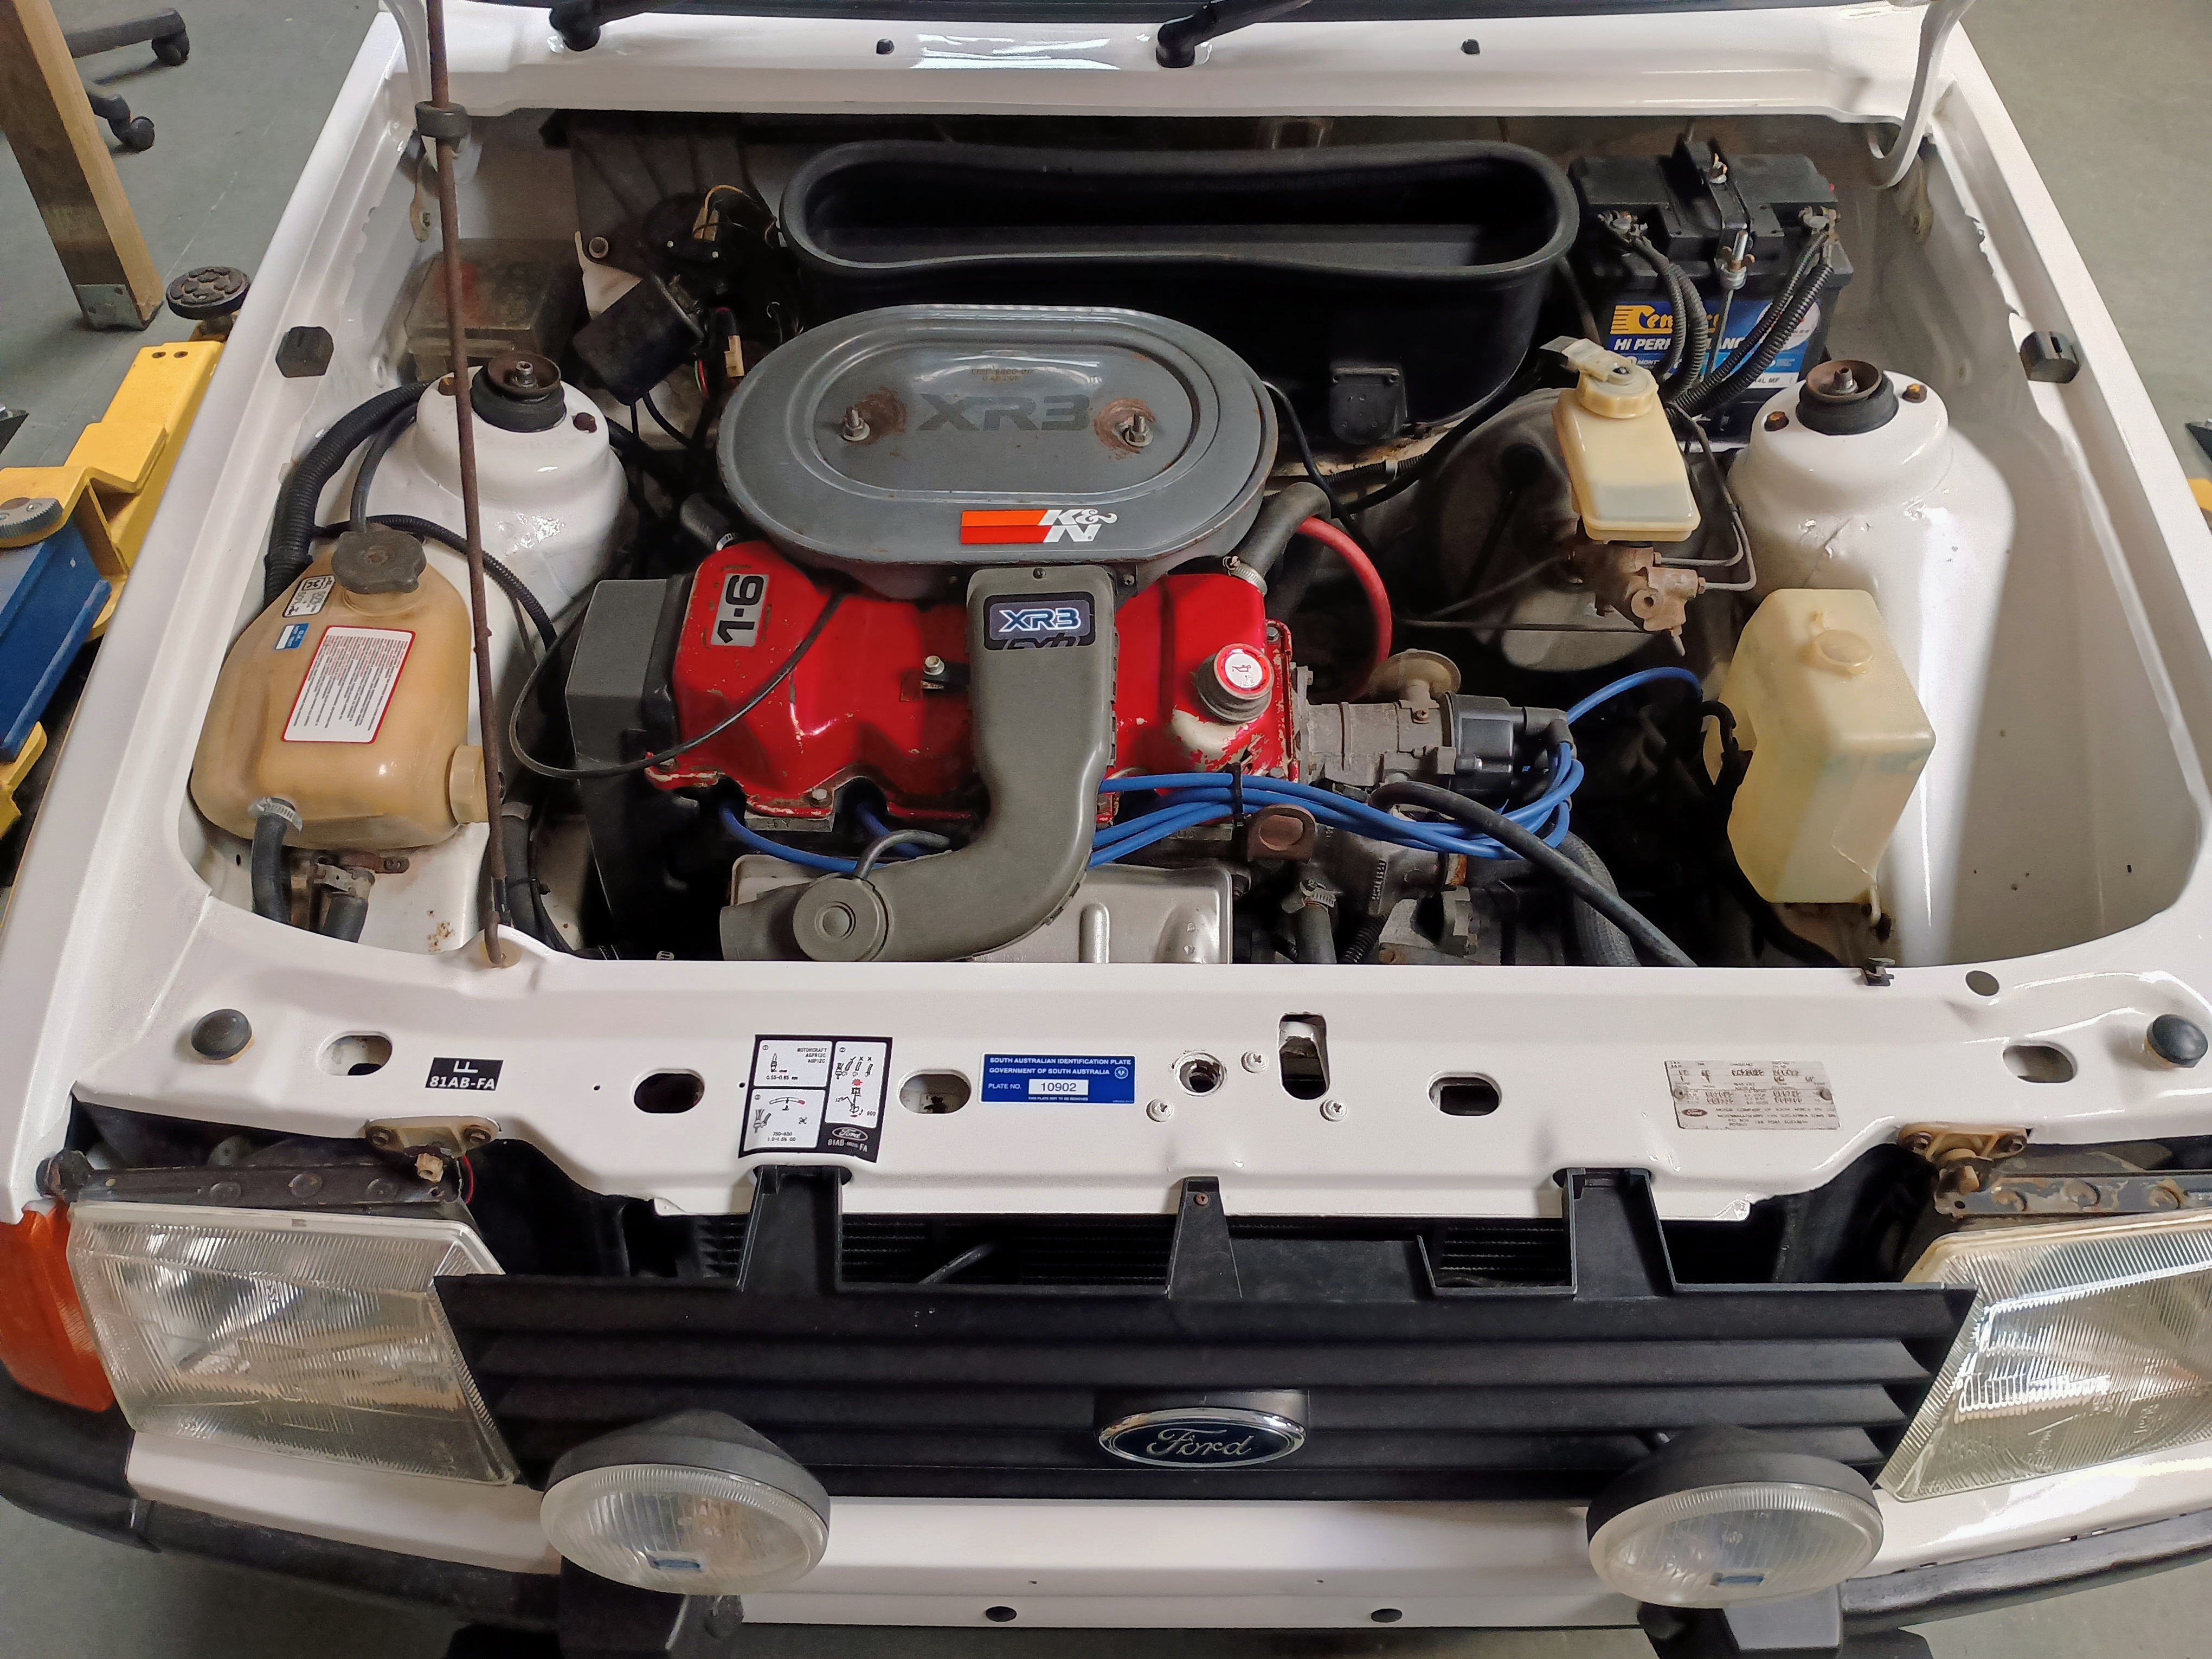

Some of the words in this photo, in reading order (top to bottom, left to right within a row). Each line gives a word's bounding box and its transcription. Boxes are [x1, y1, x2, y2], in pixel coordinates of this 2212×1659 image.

[917, 394, 1090, 431] XR3
[998, 607, 1081, 633] XR3
[429, 1076, 494, 1089] 81AB-FA
[1041, 1082, 1077, 1092] 10902
[839, 1129, 861, 1139] Ford
[859, 1143, 868, 1152] FA
[1146, 1427, 1255, 1456] Ford
